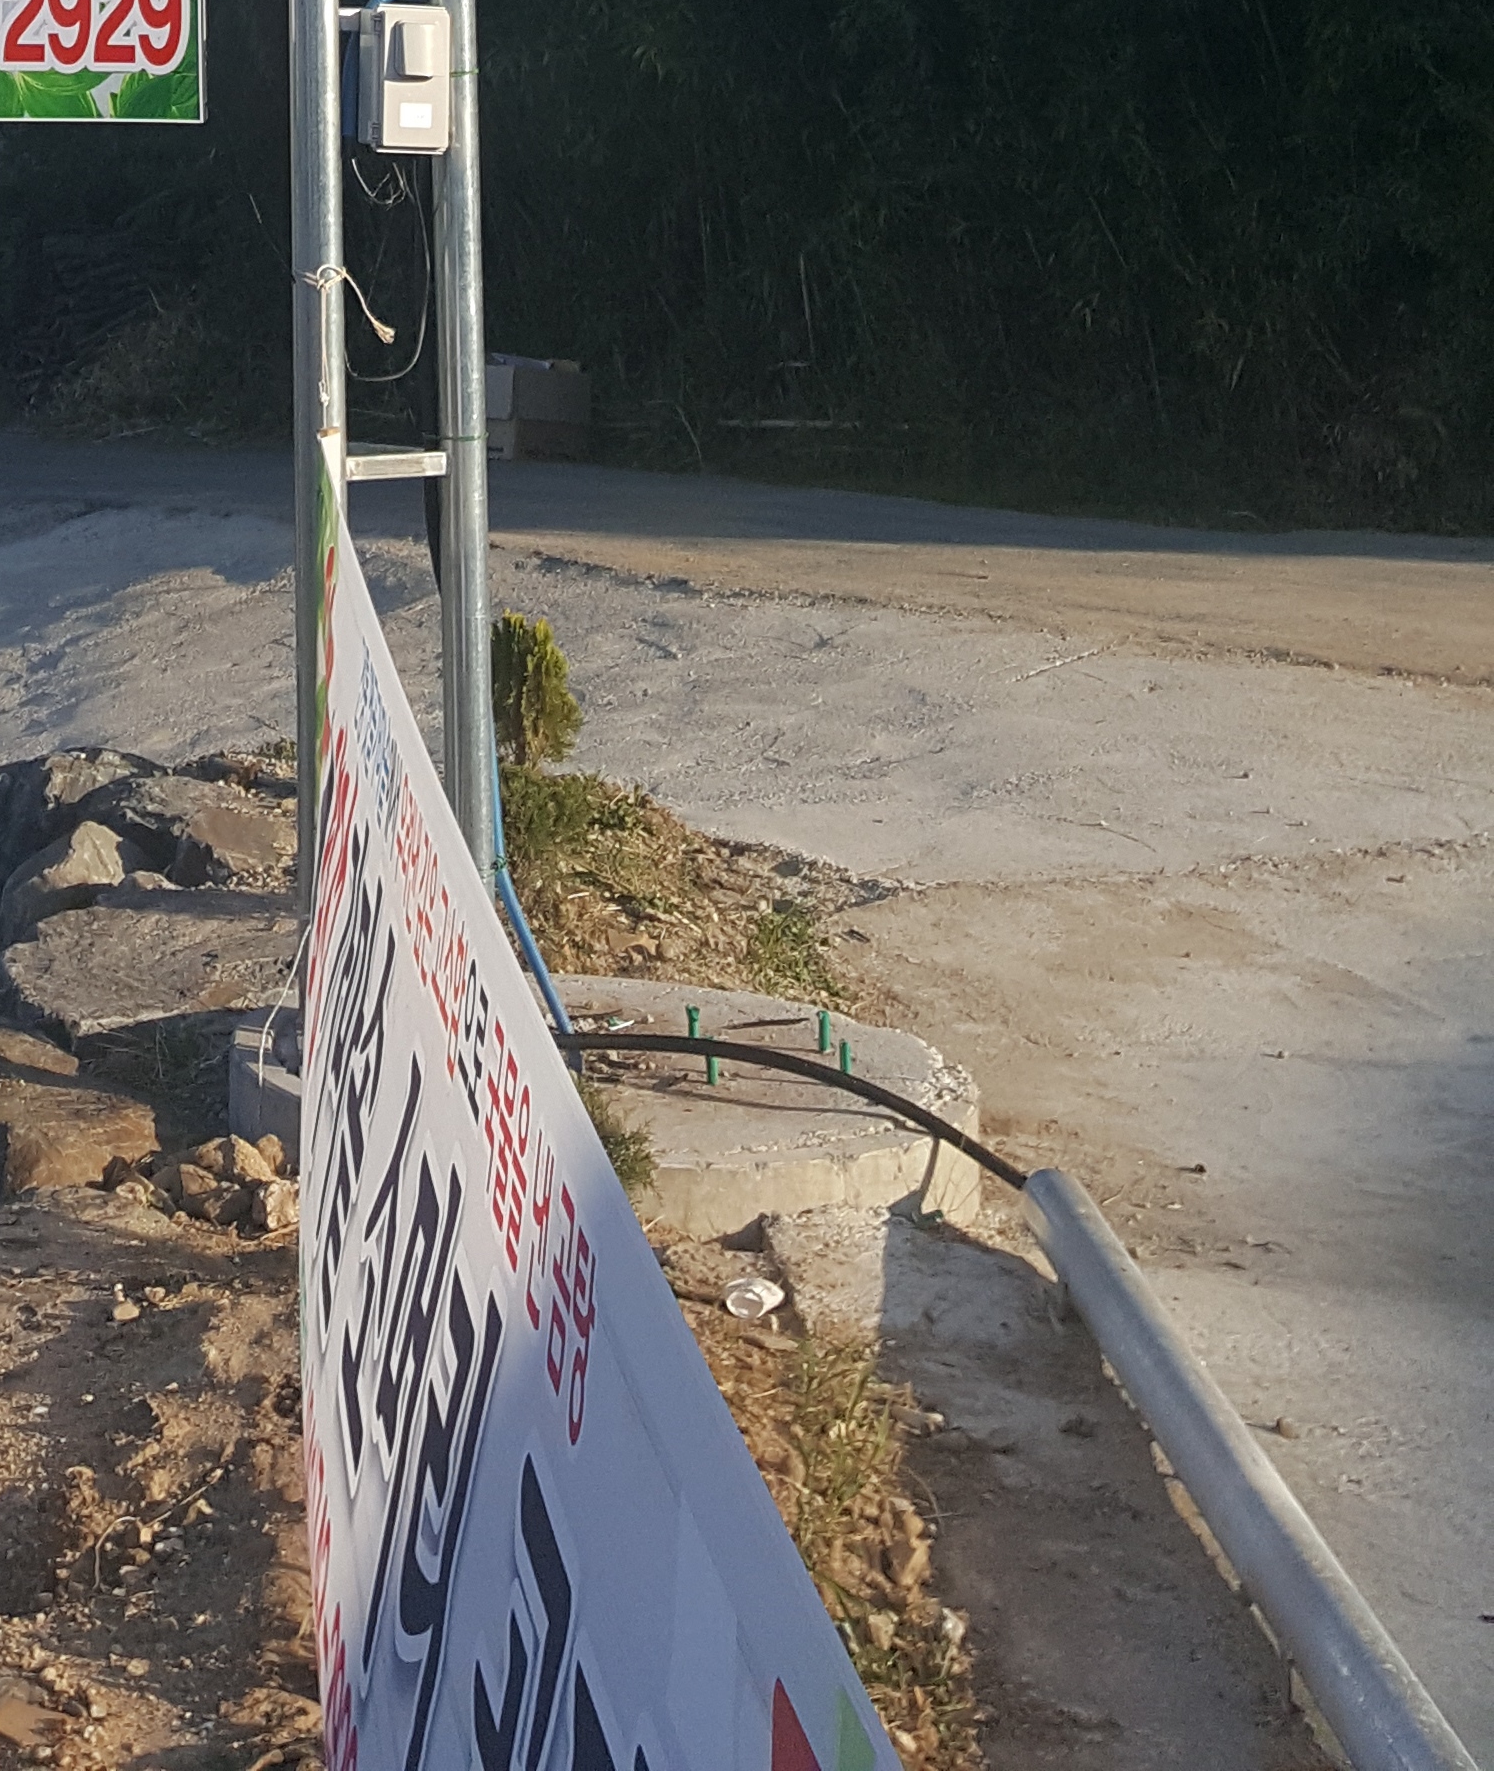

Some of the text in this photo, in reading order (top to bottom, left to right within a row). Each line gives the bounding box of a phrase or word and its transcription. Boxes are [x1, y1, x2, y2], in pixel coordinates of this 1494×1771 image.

[342, 1049, 504, 1771] 소머리
[485, 1015, 532, 1273] 국물을
[547, 1180, 598, 1447] 곰탕
